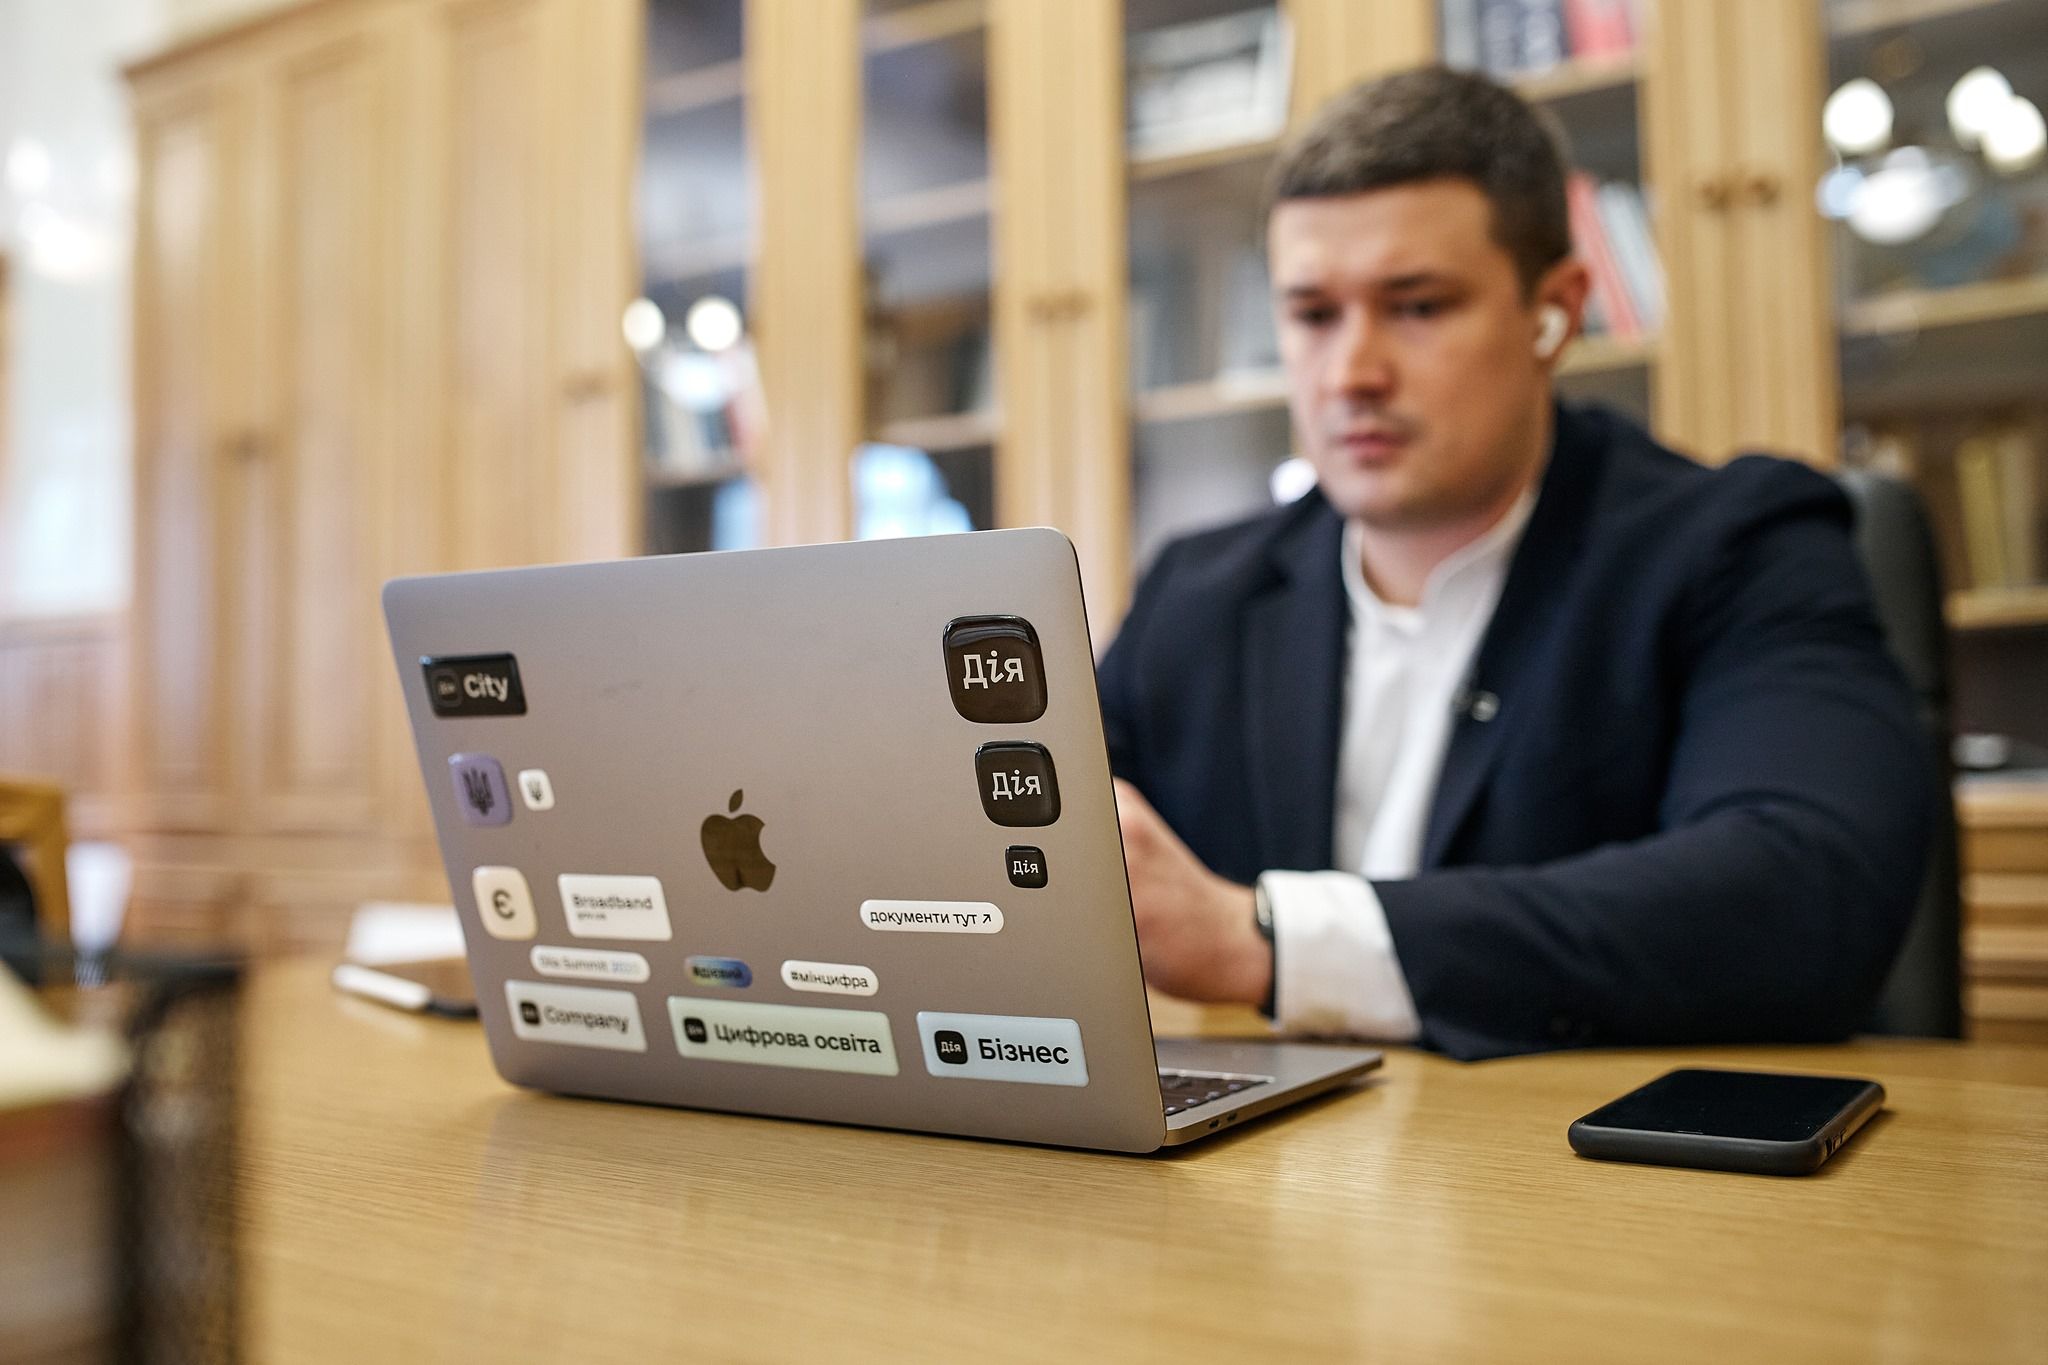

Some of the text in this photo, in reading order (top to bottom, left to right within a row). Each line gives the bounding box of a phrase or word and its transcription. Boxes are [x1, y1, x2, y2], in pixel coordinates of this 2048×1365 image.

[963, 650, 1025, 690] Дія
[463, 673, 508, 702] City
[992, 769, 1042, 801] Дія
[1013, 859, 1039, 876] Дія
[572, 894, 653, 910] Broadband
[870, 911, 977, 927] документи тут
[790, 970, 869, 988] #мінцифра
[544, 1005, 629, 1034] Company
[714, 1024, 810, 1049] Цифрова
[815, 1033, 881, 1053] освіта
[941, 1038, 1070, 1064] Дія Бізнес
